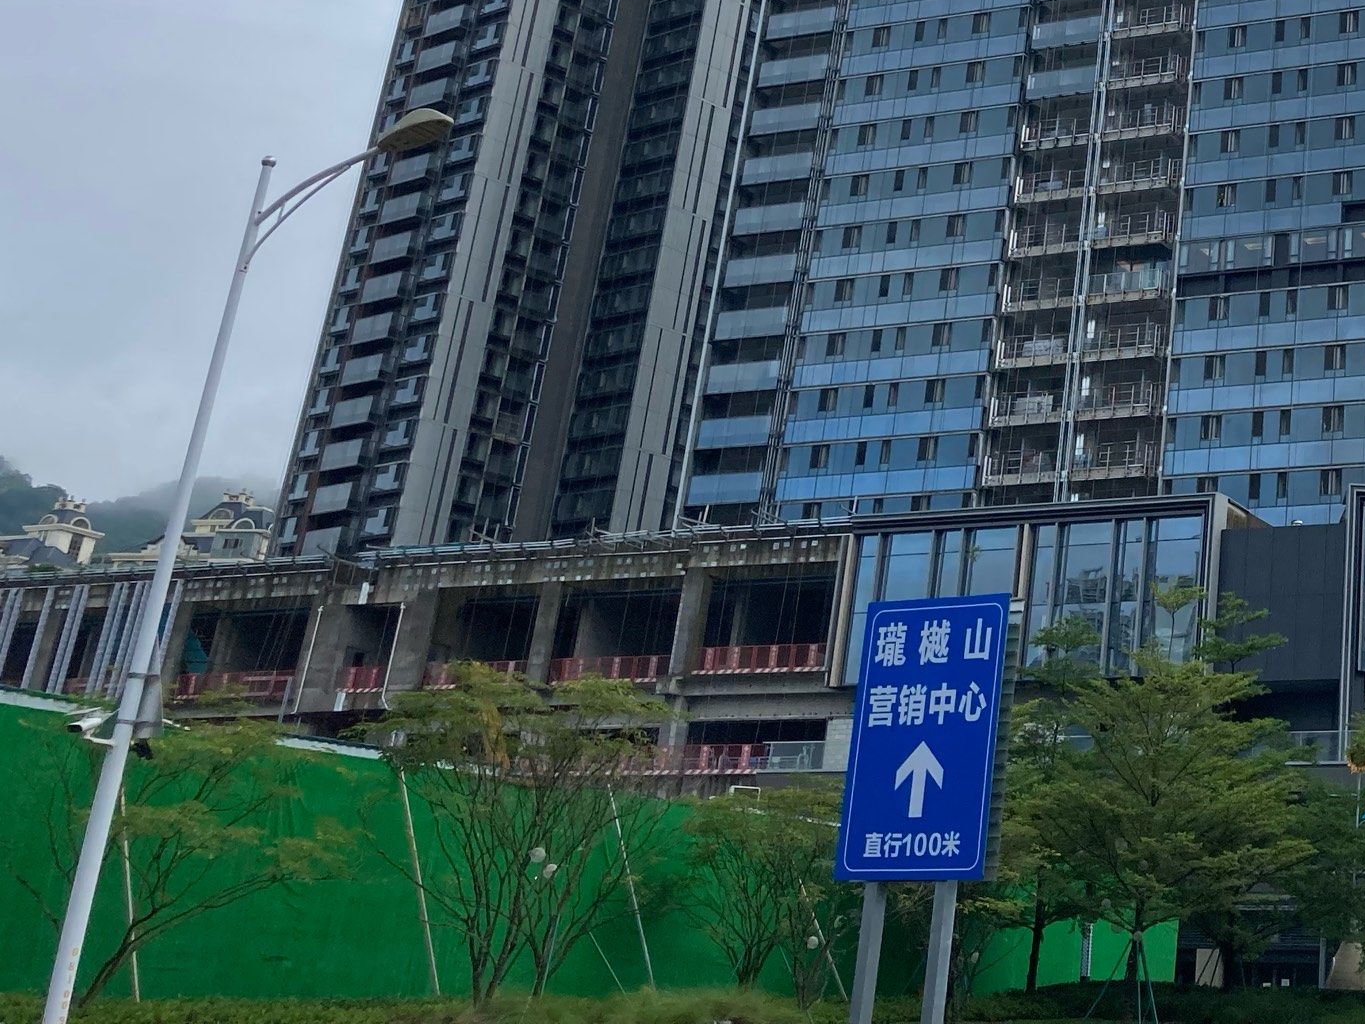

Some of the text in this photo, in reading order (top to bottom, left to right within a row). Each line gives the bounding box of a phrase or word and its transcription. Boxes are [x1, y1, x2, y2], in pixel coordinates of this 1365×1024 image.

[868, 681, 988, 728] 营销中心
[863, 831, 961, 858] 直行100米
